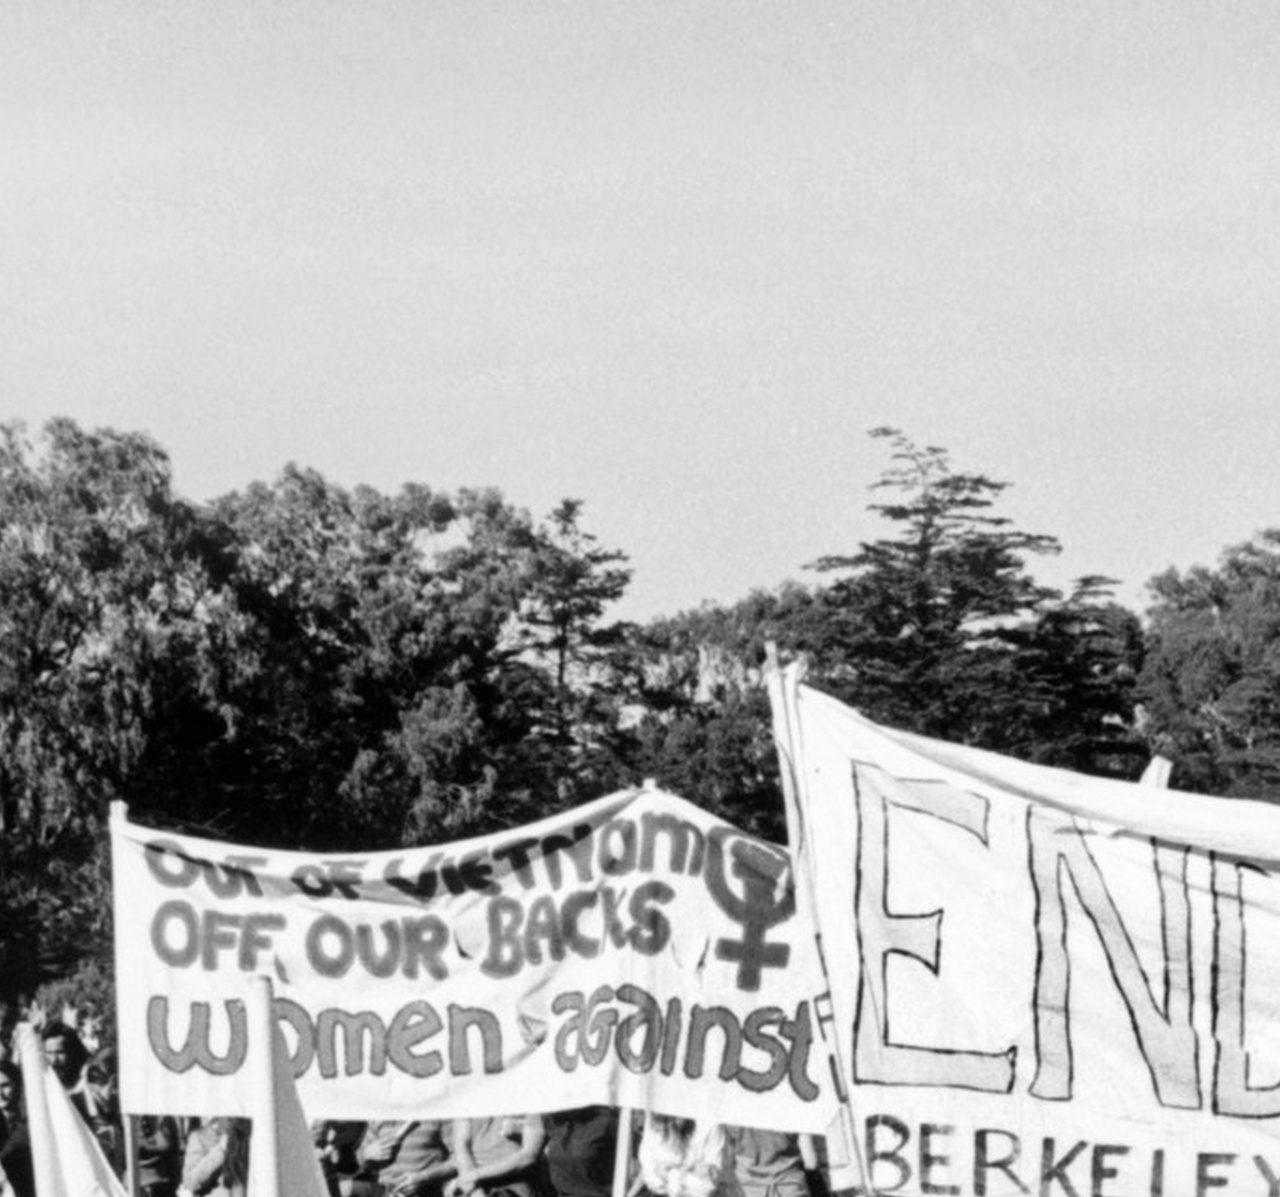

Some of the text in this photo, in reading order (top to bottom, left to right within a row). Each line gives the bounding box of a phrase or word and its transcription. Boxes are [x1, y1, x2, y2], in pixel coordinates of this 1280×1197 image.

[144, 838, 267, 900] OUT
[291, 857, 370, 899] OF
[150, 881, 675, 980] OFF OUR BACKS
